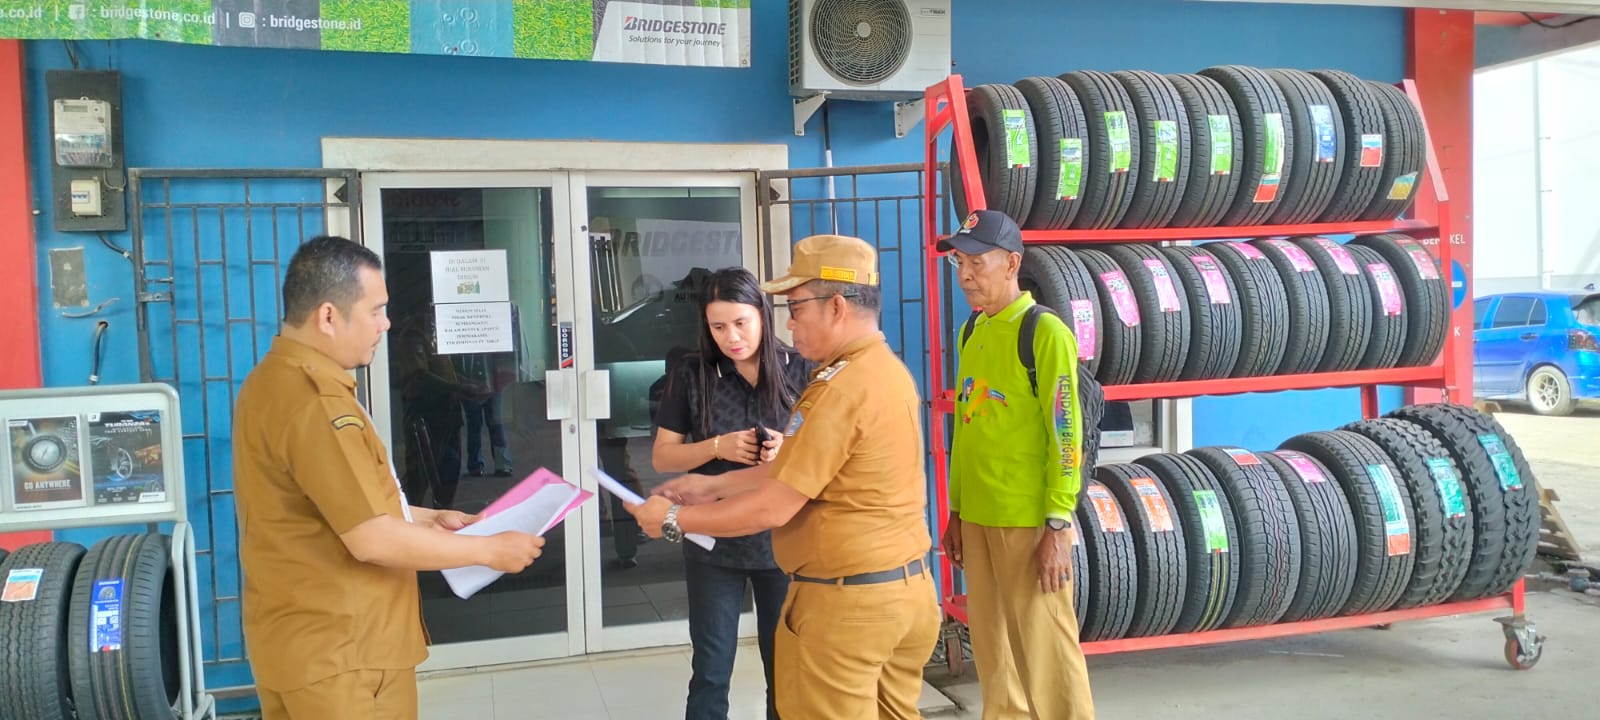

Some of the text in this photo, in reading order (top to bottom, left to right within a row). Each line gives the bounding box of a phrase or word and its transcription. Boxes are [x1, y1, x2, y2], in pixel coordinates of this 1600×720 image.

[100, 6, 216, 24] bridgestone.co.id
[270, 14, 361, 31] bridgestone.id
[624, 16, 727, 35] BRIDGESTONE
[628, 35, 721, 48] Solutions for your journey
[1058, 375, 1074, 478] KENDARI BerGeRAK
[24, 479, 71, 490] GO ANYWHERE
